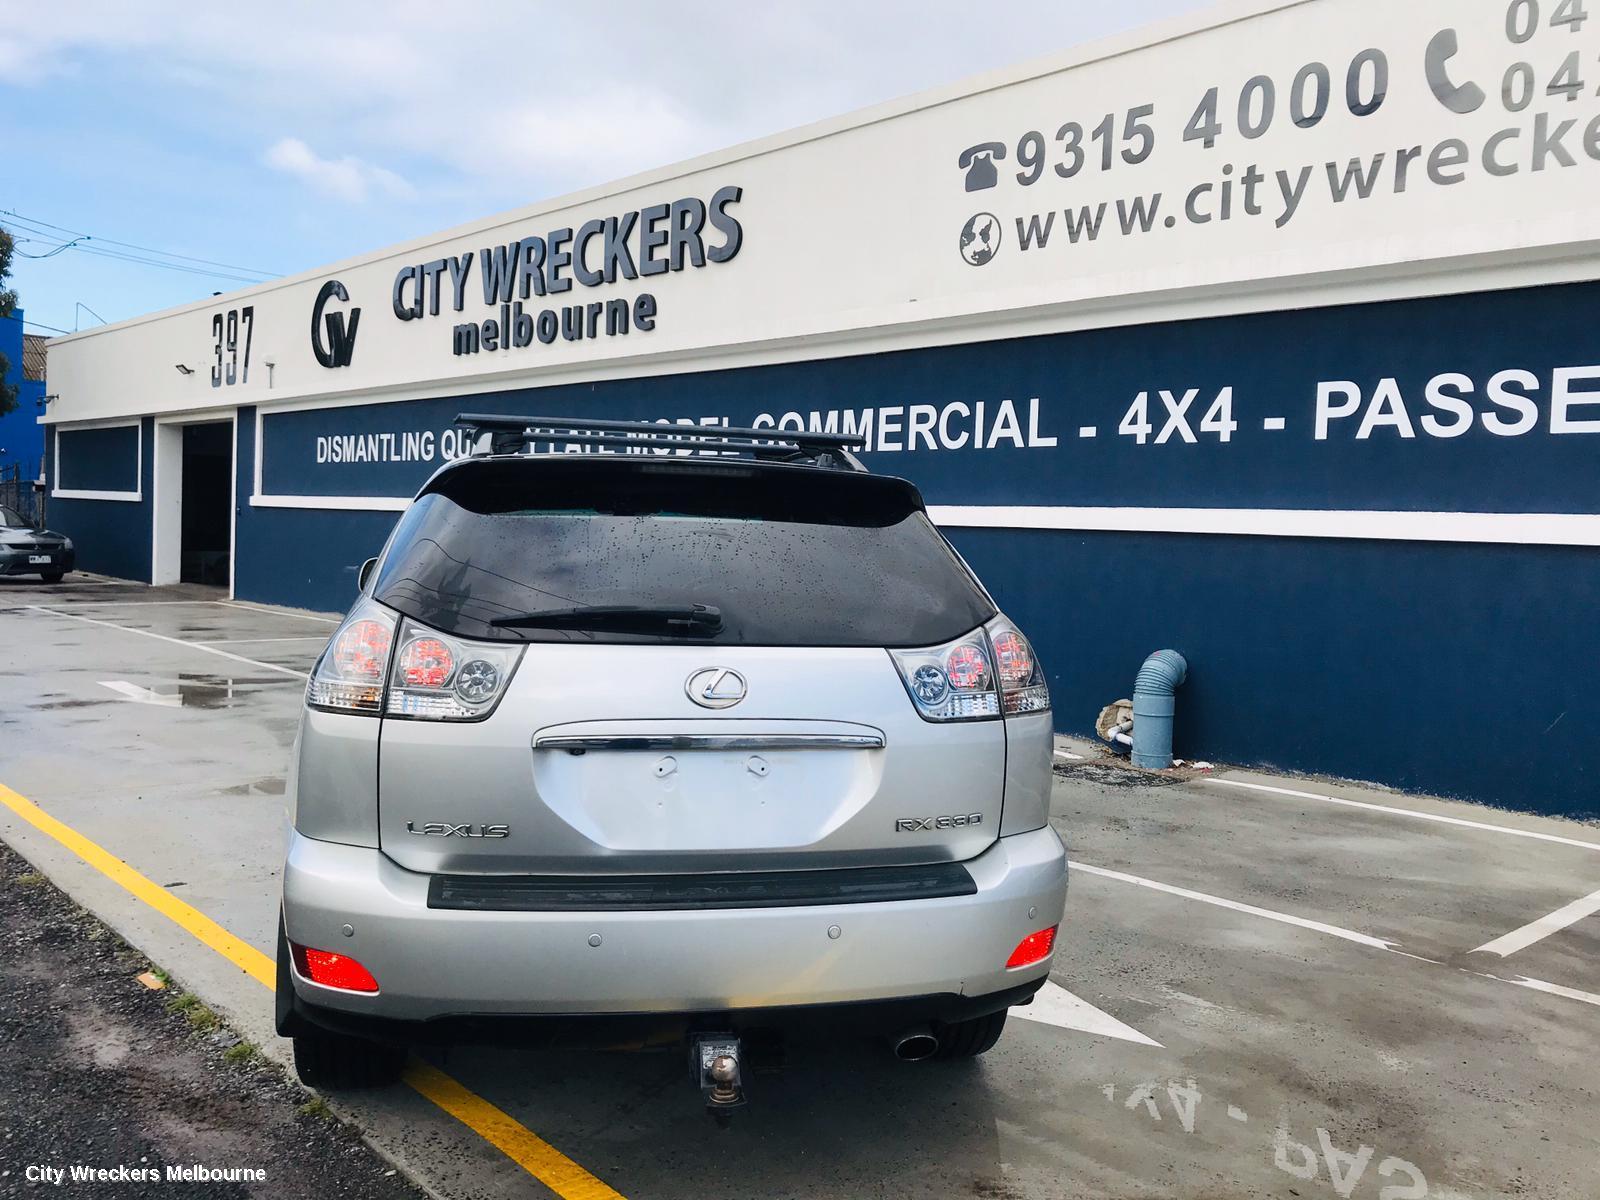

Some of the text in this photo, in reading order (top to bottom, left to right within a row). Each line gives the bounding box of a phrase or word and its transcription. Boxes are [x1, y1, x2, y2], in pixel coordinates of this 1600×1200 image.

[1015, 48, 1389, 187] 9315 4000
[1501, 51, 1600, 113] 04
[392, 185, 743, 321] CITY WRECKERS
[211, 306, 254, 388] 397
[453, 293, 658, 356] melbourne
[316, 430, 435, 463] DISMANTLING
[752, 398, 1057, 452] COMMERCIAL
[1118, 386, 1238, 444] 4X4
[1314, 365, 1600, 440] PASSE
[407, 821, 509, 838] LEXUS
[896, 813, 983, 832] RX 330
